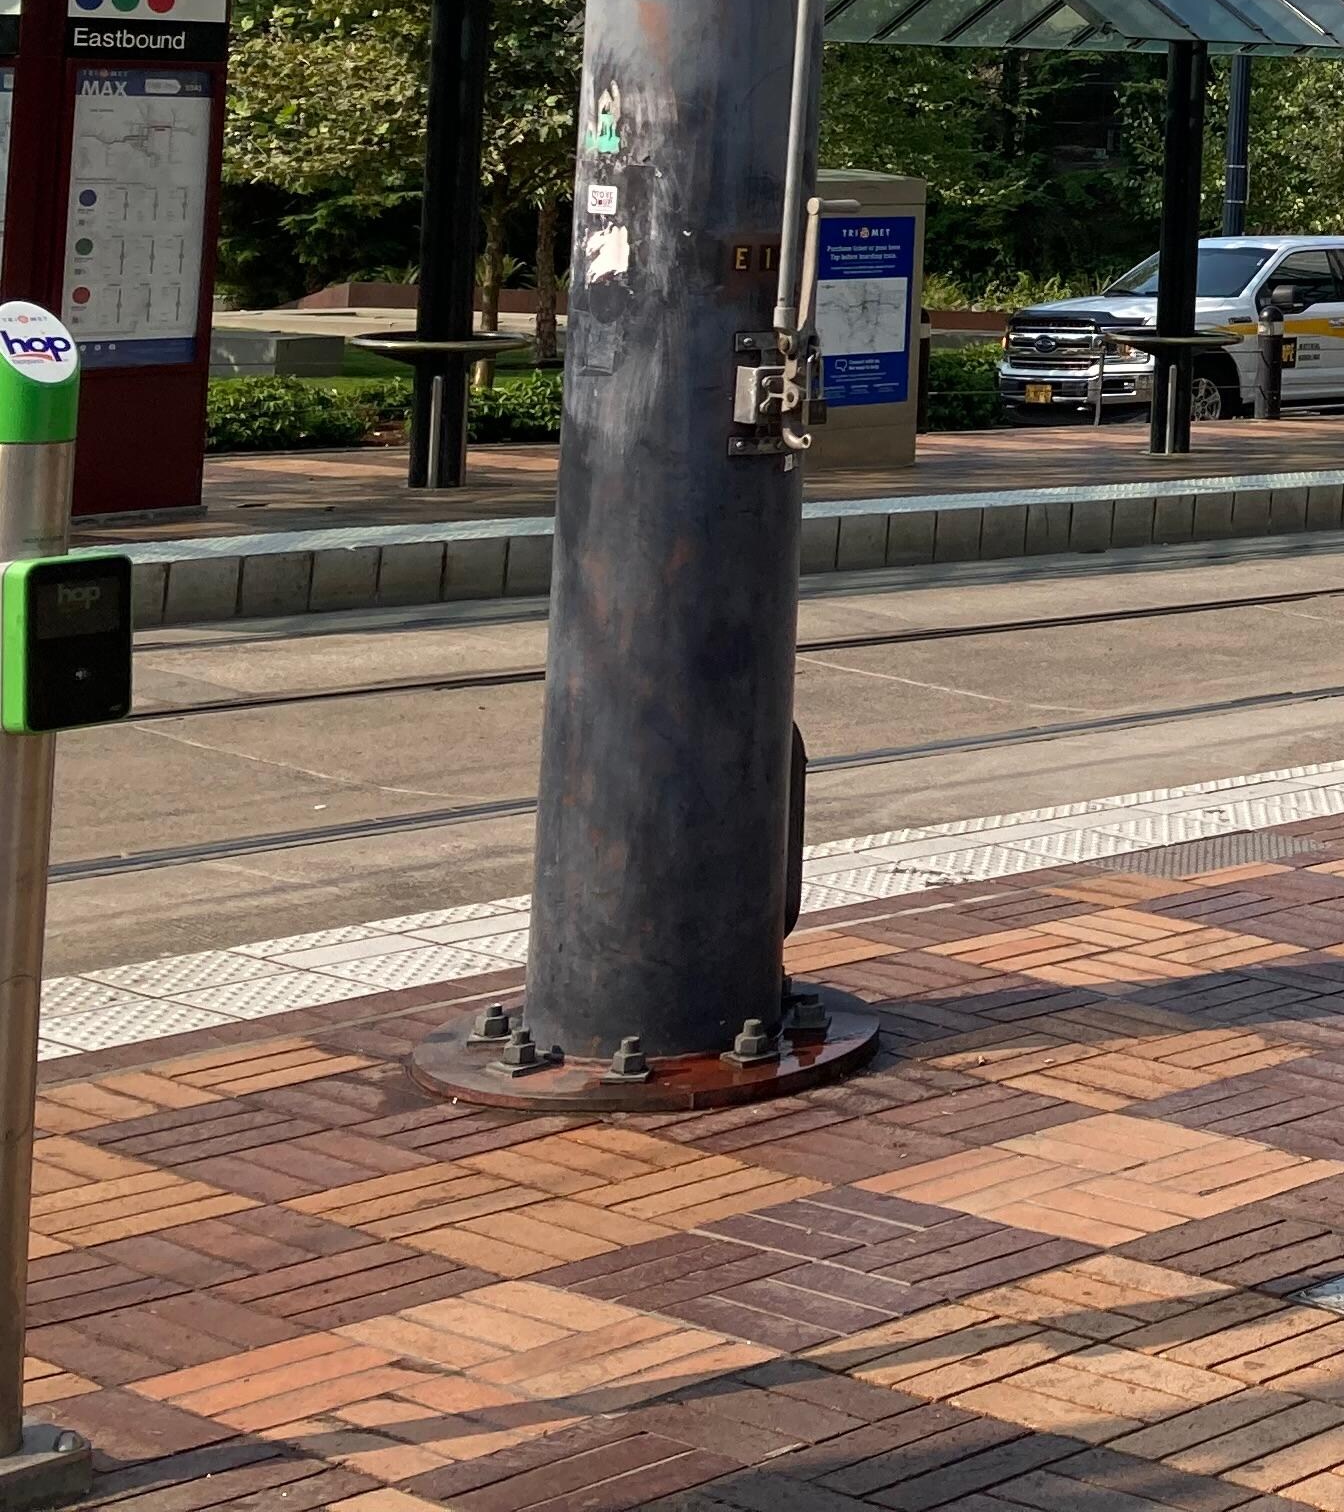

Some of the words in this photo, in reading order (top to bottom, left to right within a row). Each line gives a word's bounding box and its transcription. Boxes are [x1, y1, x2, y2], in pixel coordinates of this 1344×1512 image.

[73, 28, 186, 49] Eastbound
[81, 80, 128, 96] MAX
[842, 229, 859, 237] TRI
[871, 229, 891, 237] MET
[736, 247, 748, 270] E
[0, 330, 71, 362] hop
